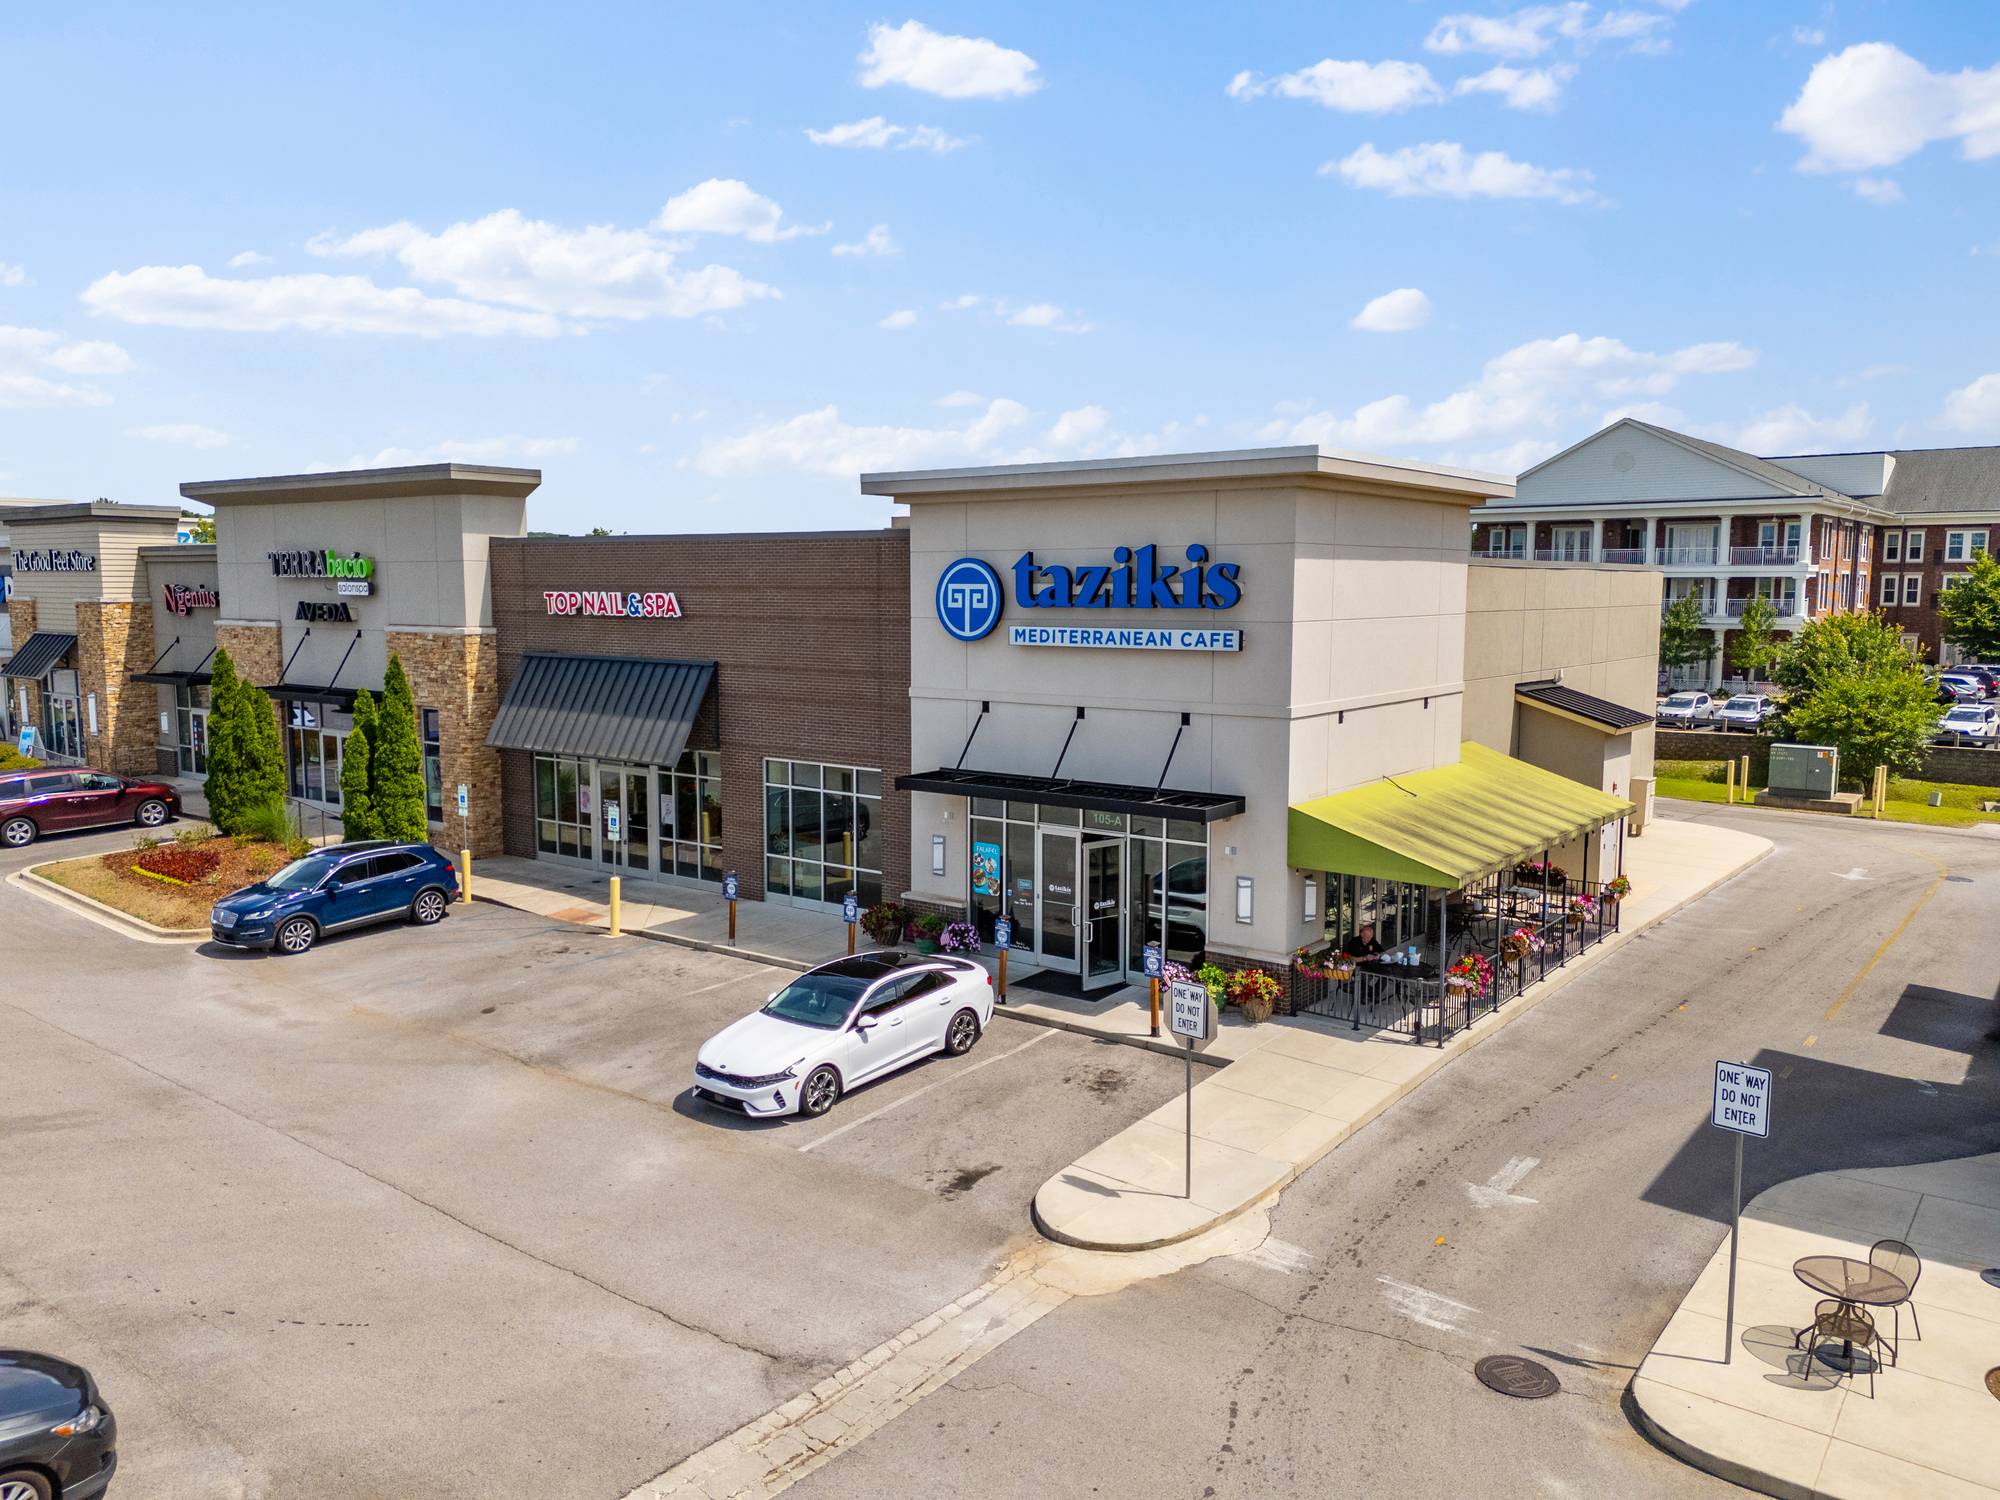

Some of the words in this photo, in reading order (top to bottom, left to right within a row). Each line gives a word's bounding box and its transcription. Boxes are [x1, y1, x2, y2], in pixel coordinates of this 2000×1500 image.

[13, 550, 28, 571] The
[29, 550, 51, 571] Good
[52, 550, 70, 571] Feet
[70, 550, 94, 571] Store
[1012, 543, 1242, 610] tazikis
[295, 600, 353, 622] AVEDA
[544, 592, 581, 615] TOP
[582, 592, 626, 616] NAIL
[627, 592, 642, 617] &
[643, 592, 682, 617] SPA
[1014, 628, 1173, 647] MEDITERRANEAN
[1180, 631, 1234, 649] CAFE
[1094, 813, 1122, 826] 105-A
[1173, 987, 1188, 1000] ONE
[1189, 990, 1203, 1004] WAY
[1175, 1003, 1185, 1014] DO
[1187, 1006, 1200, 1018] NOT
[1178, 1017, 1198, 1032] ENTER
[1719, 1069, 1740, 1085] ONE
[1745, 1075, 1766, 1091] WAY
[1721, 1088, 1736, 1102] DO
[1740, 1093, 1761, 1108] NOT
[1724, 1107, 1756, 1126] ENTER
